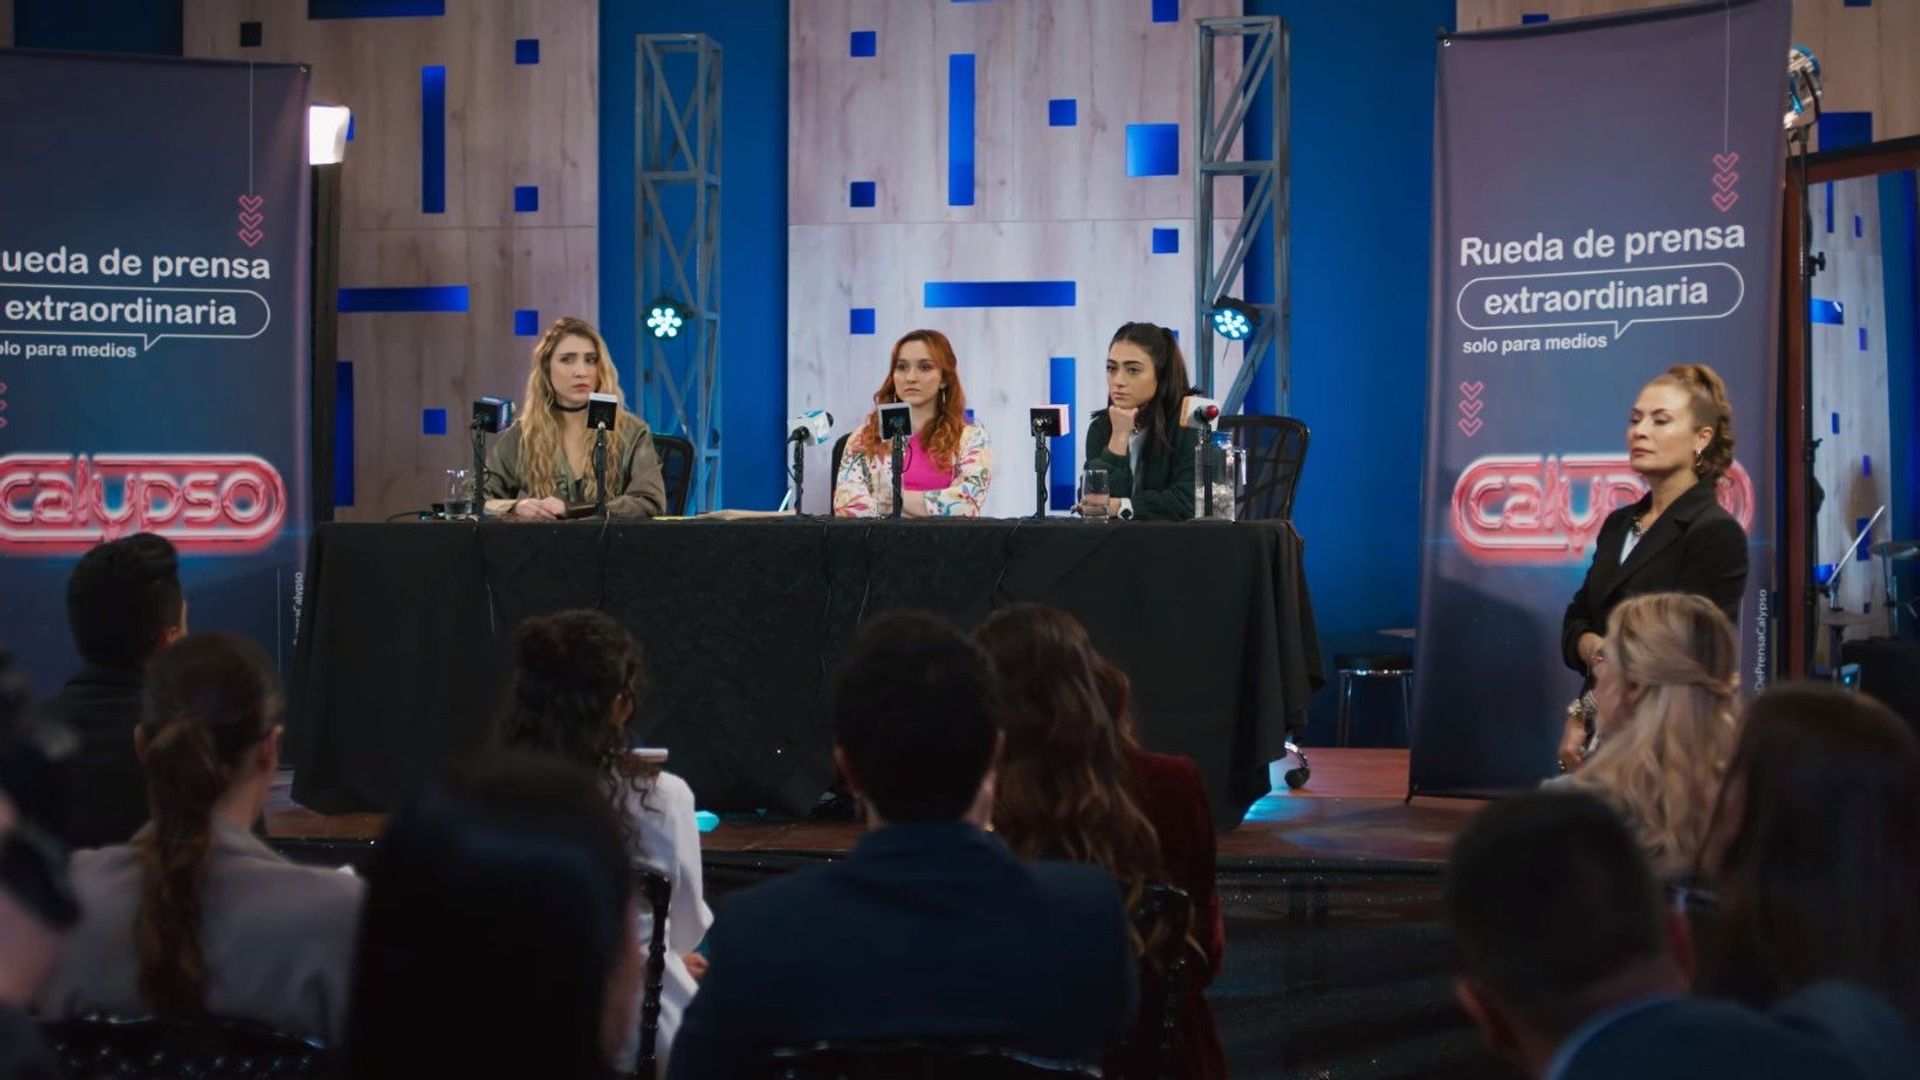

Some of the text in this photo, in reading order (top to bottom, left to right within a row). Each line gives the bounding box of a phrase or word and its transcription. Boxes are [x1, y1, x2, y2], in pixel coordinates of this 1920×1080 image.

[0, 245, 271, 283] ueda de prensa
[1460, 224, 1745, 267] Rueda de prensa
[5, 295, 237, 326] extraordinaria
[1484, 276, 1709, 315] extraordinaria
[0, 341, 137, 359] lo para medios
[1462, 333, 1608, 356] solo para medios
[0, 454, 268, 542] calypso
[1469, 455, 1736, 554] calyp
[1754, 589, 1768, 694] DePrensaCalypso
